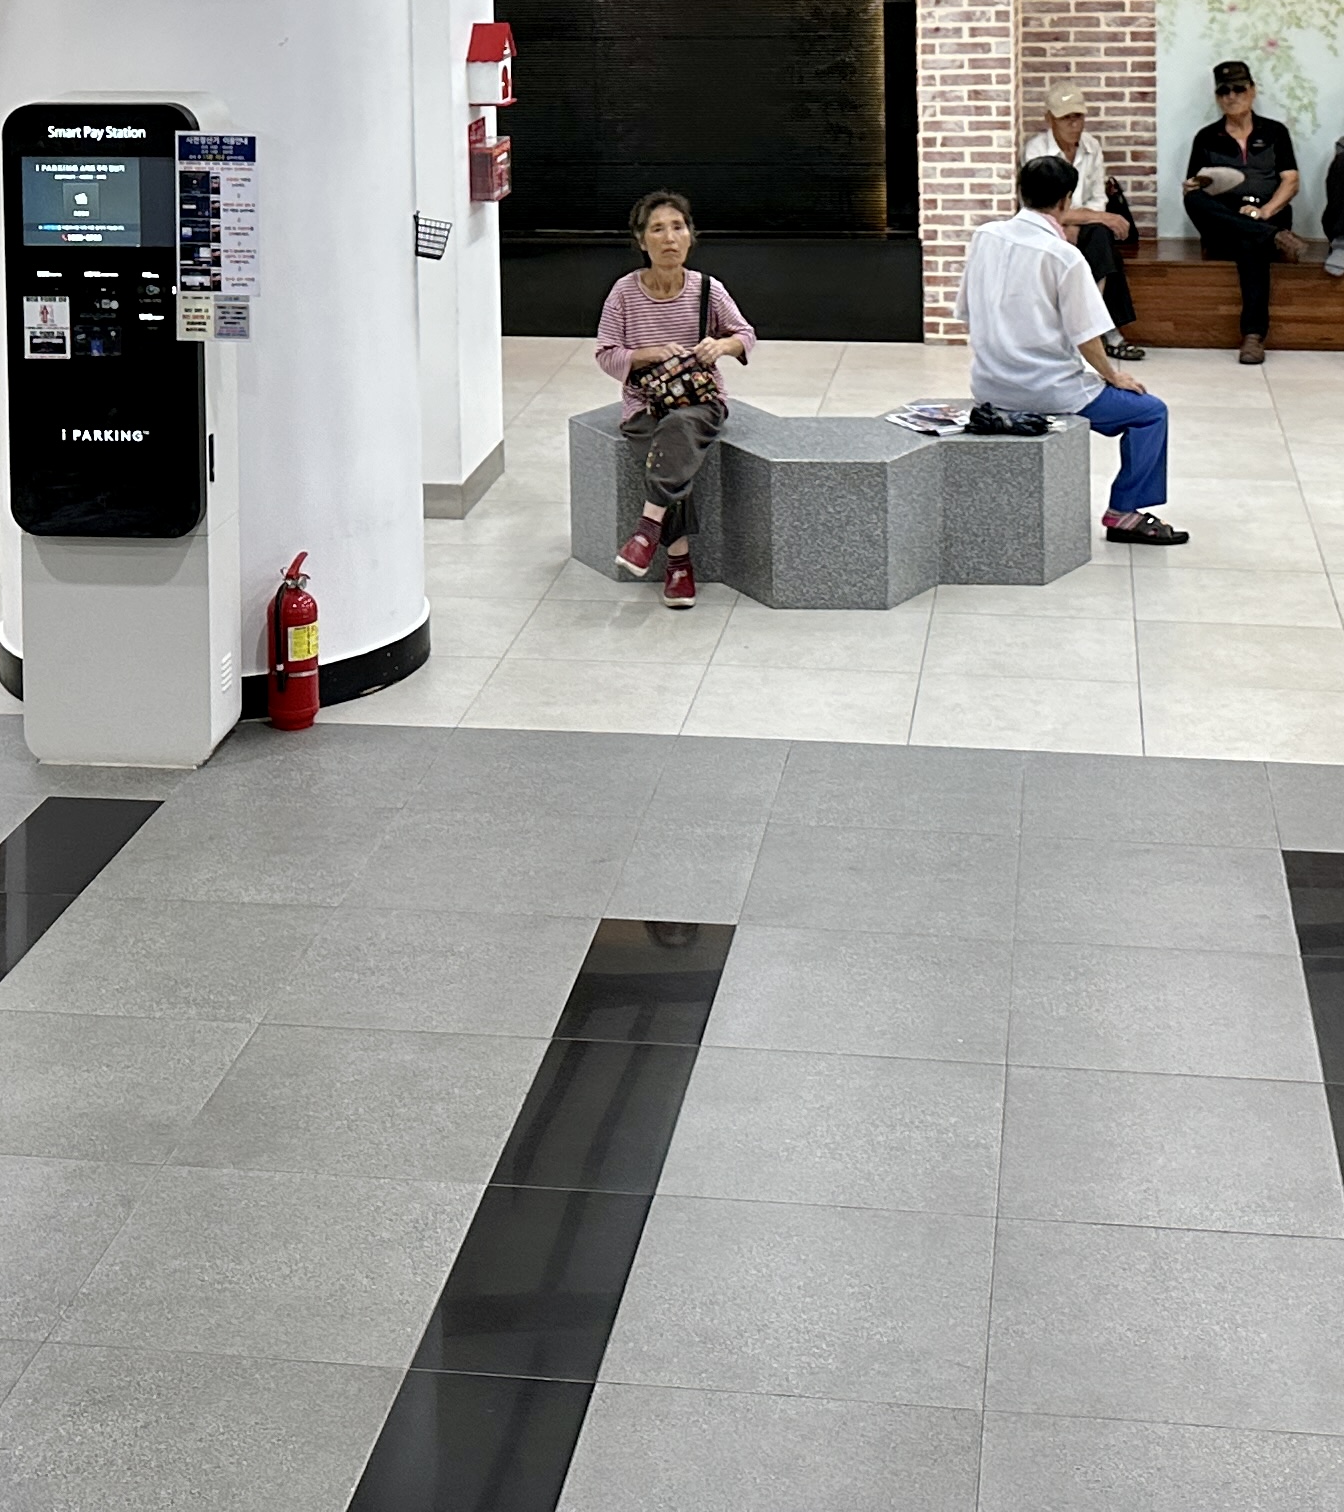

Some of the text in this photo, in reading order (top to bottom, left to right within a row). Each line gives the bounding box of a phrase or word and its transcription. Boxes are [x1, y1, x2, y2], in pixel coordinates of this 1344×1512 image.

[47, 125, 147, 142] Smart Pay Station
[72, 429, 145, 443] PARKING
